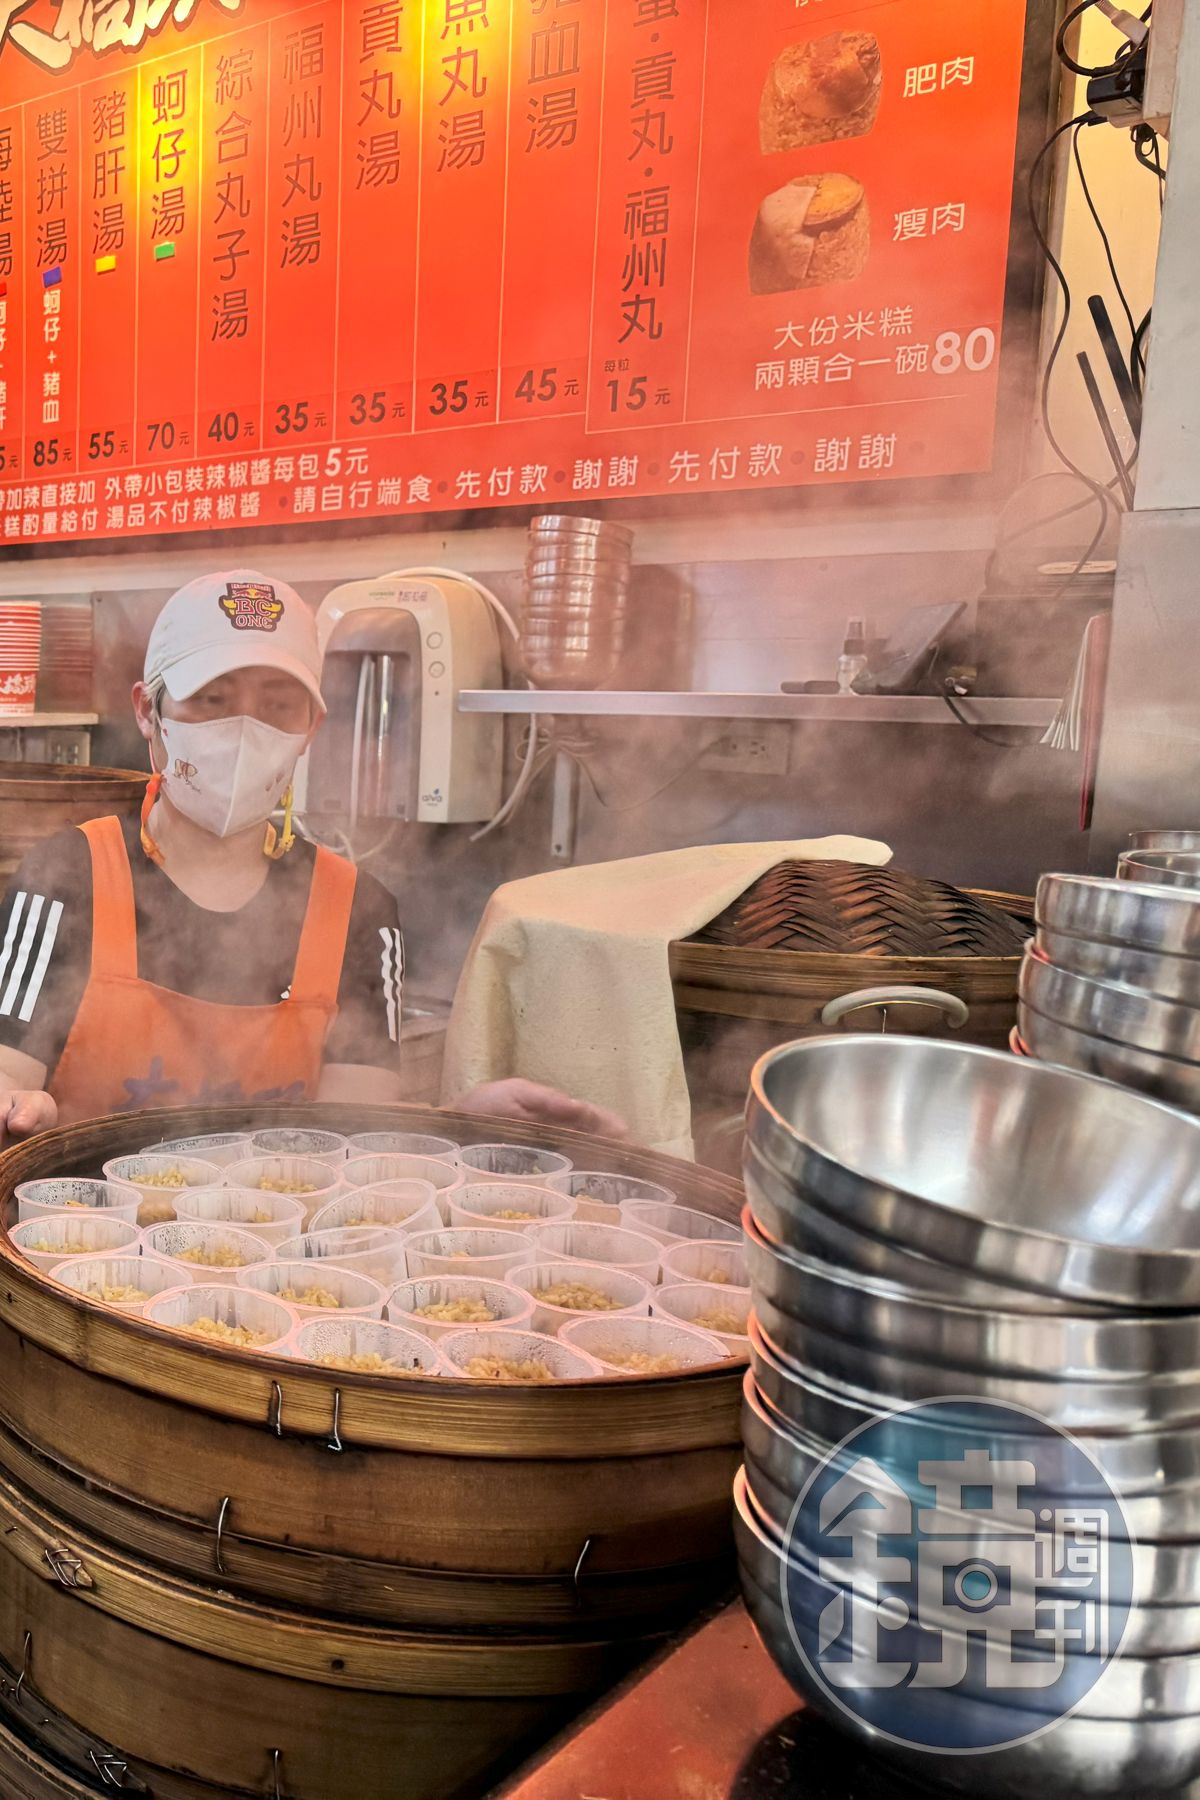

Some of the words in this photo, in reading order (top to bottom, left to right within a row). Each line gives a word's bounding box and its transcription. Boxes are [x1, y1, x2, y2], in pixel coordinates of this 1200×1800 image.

[356, 0, 402, 190] 貢丸湯
[525, 0, 580, 153] 血湯
[903, 56, 975, 98] 肥肉
[36, 107, 68, 268] 雙拼湯
[92, 89, 126, 254] 豬肝湯
[151, 68, 188, 240] 蚵仔湯
[211, 48, 253, 341] 綜合丸子湯
[281, 22, 325, 269] 福州丸湯
[892, 202, 965, 242] 瘦肉
[603, 357, 630, 373] 每粒
[773, 304, 913, 350] 大份米糕
[105, 491, 262, 530] 湯品不付辣椒醬
[293, 475, 433, 515] 請自行端食
[454, 463, 548, 500] 先付款
[572, 455, 639, 491] 謝謝
[668, 442, 783, 484] 先付款
[813, 433, 897, 474] 謝謝
[235, 598, 272, 616] BC
[235, 614, 273, 629] ONE
